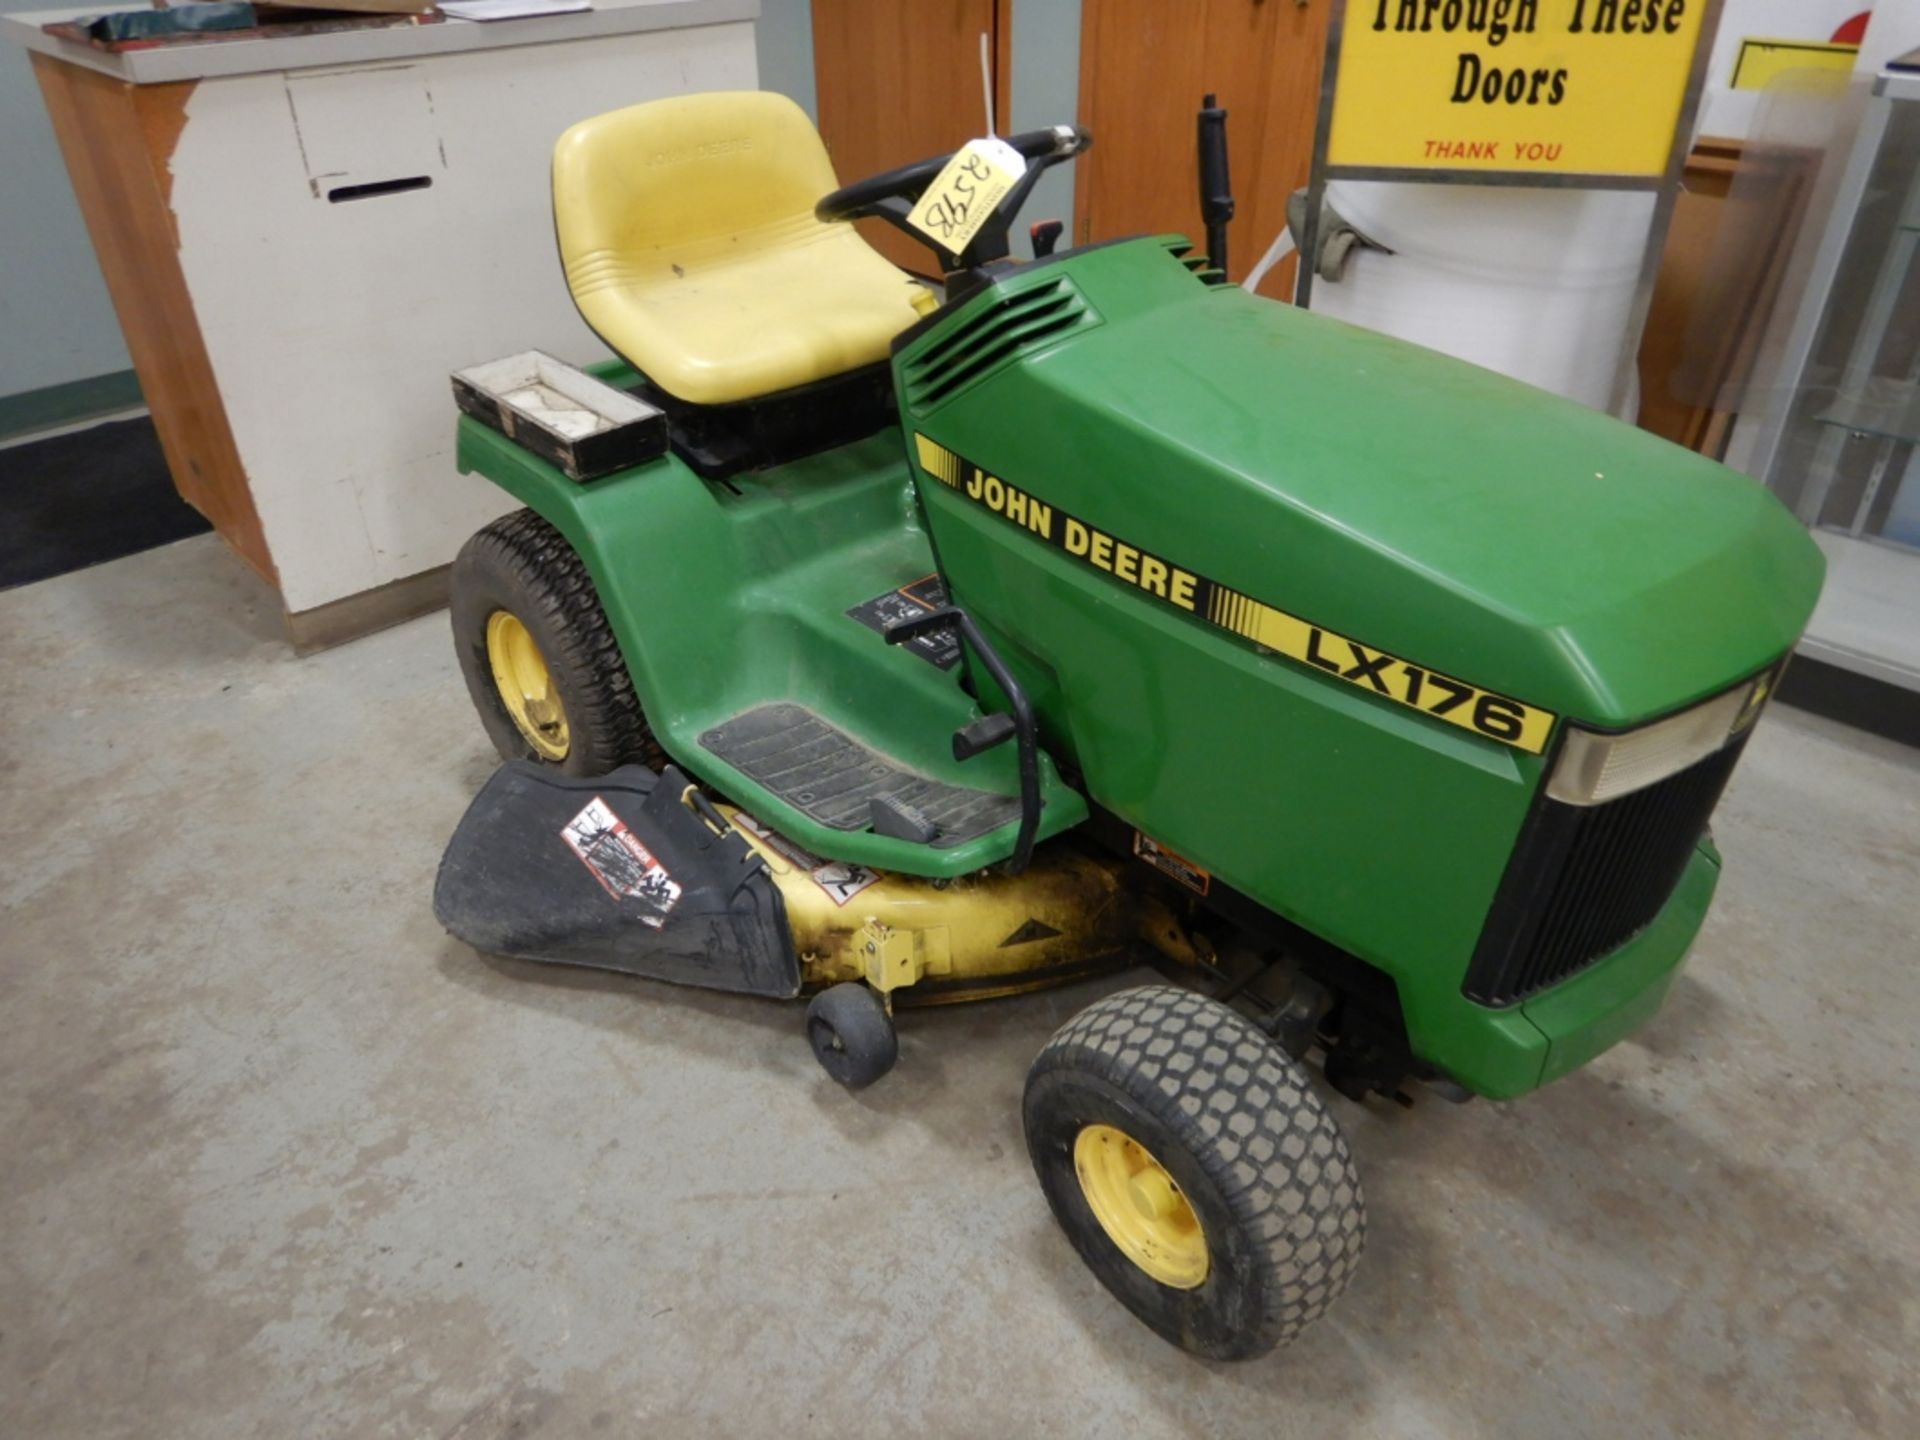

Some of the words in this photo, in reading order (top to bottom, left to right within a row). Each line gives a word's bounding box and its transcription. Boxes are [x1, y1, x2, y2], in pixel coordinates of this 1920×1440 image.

[1373, 0, 1538, 46] Through
[1567, 0, 1685, 34] These
[1450, 52, 1568, 106] Doors
[1424, 140, 1499, 160] THANK
[1514, 142, 1563, 162] YOU
[966, 468, 1052, 540] JOHN
[1064, 517, 1198, 612] DEERE
[1305, 627, 1526, 742] LX176
